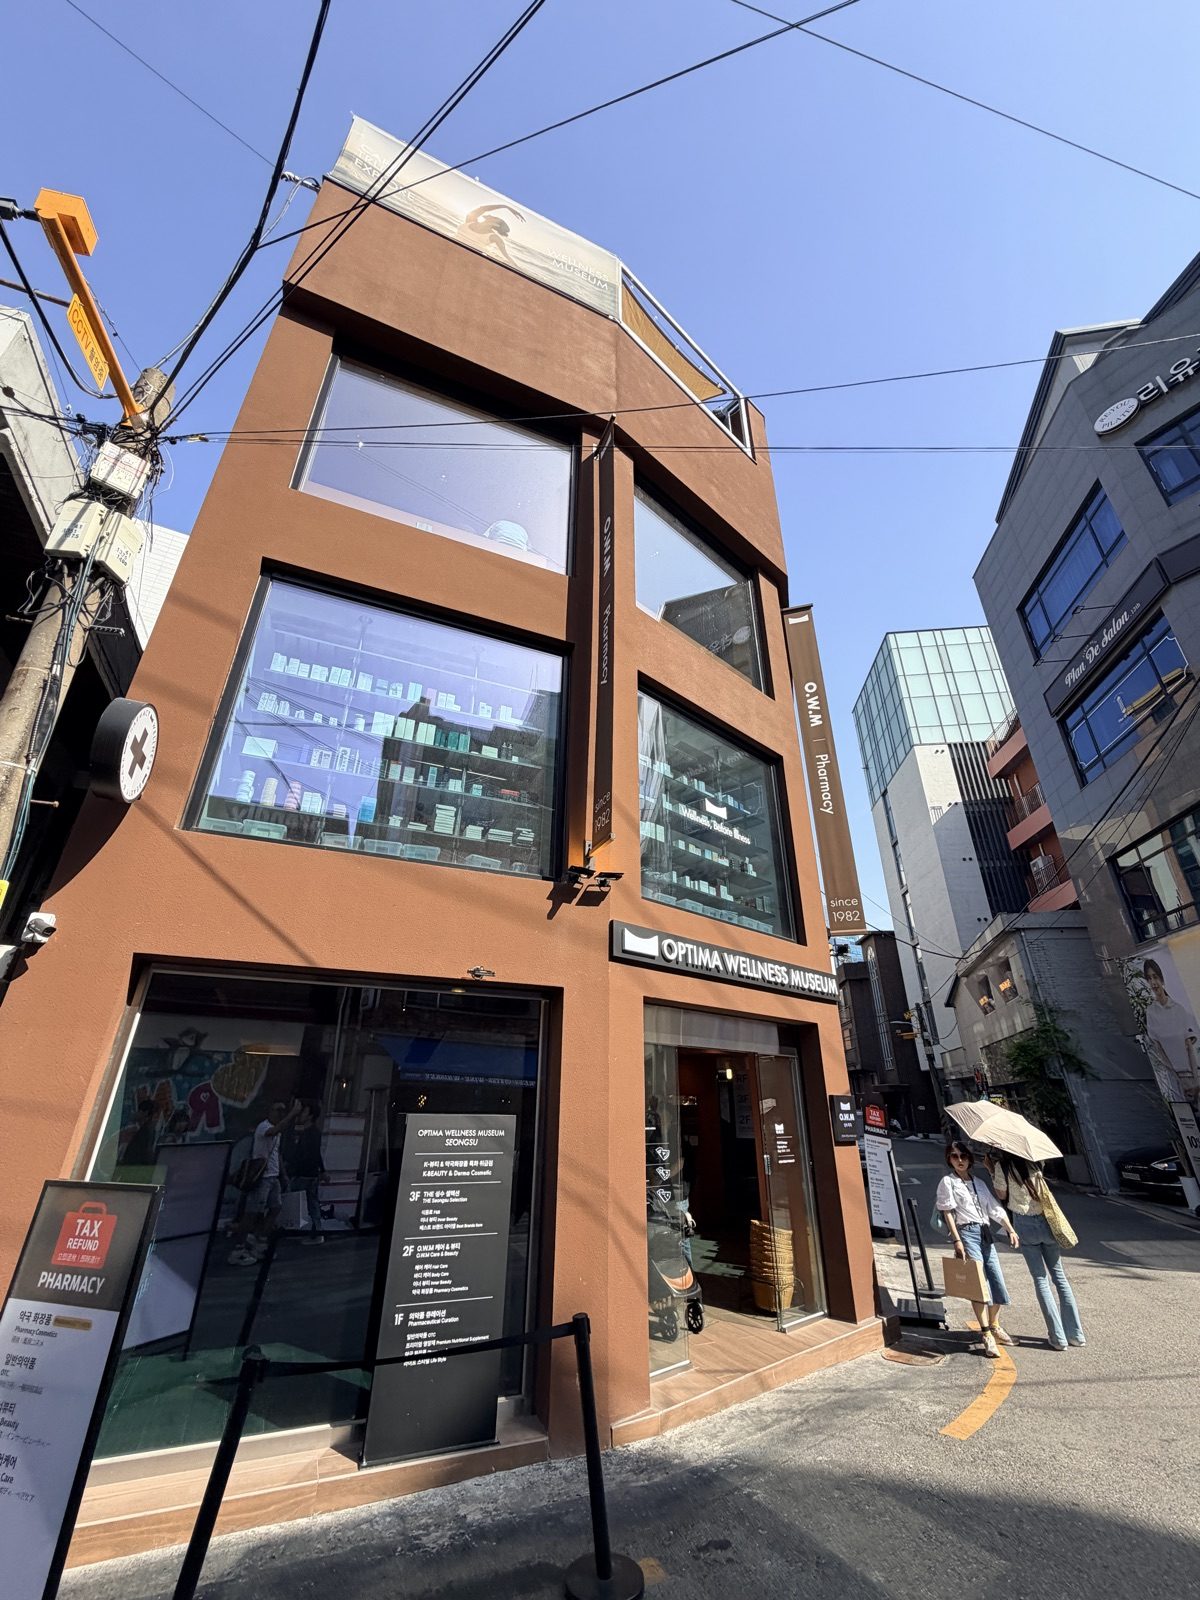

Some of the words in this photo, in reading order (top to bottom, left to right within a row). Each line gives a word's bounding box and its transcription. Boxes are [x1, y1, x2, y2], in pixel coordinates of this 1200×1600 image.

[552, 259, 608, 290] MUSEUM
[72, 309, 92, 350] CCTV
[1064, 662, 1086, 688] Plan
[1085, 644, 1101, 665] De
[1101, 611, 1130, 648] Salon
[804, 682, 823, 727] O.W.M
[815, 753, 835, 815] Pharmacy
[595, 792, 611, 813] since
[711, 819, 733, 837] Before
[830, 896, 859, 908] since
[833, 910, 861, 922] 1982
[661, 938, 723, 971] OPTIMA
[723, 952, 788, 984] WELLNESS
[790, 968, 838, 995] MUSEUM
[838, 1113, 855, 1121] O.W.M
[869, 1109, 880, 1117] TAX
[864, 1125, 888, 1135] PHARMACY
[409, 1192, 420, 1201] 3F
[75, 1219, 103, 1237] TAX
[66, 1238, 99, 1251] REFUND
[402, 1245, 414, 1256] 2F
[37, 1271, 106, 1295] PHARMACY
[19, 1310, 32, 1322] 약국
[33, 1312, 52, 1326] 화장품
[394, 1313, 404, 1326] 1F
[408, 1318, 441, 1327] Pharmaceutical
[14, 1326, 36, 1336] Pharmacy
[36, 1328, 58, 1338] Cosmetics
[4, 1354, 37, 1370] 일반의약품
[1, 1472, 14, 1484] Care
